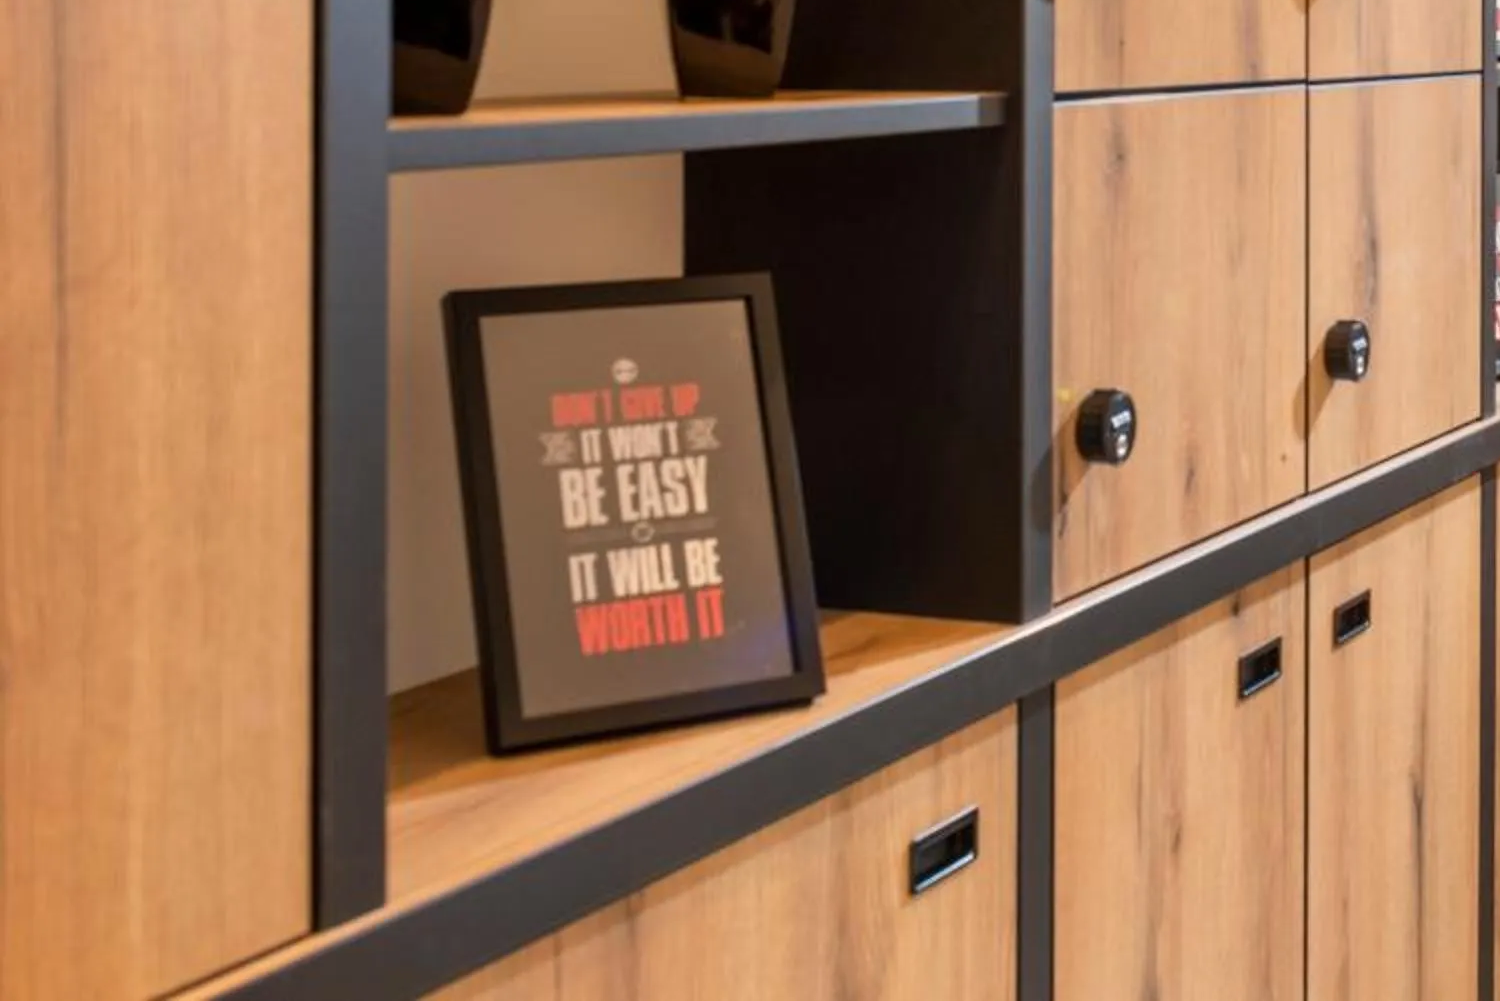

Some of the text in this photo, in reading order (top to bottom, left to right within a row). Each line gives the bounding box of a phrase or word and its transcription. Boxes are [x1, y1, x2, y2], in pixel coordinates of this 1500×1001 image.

[669, 382, 699, 416] UP
[580, 420, 679, 464] IT WON'T
[560, 455, 708, 528] BE EASY
[569, 537, 724, 603] IT WILL BE
[575, 587, 724, 656] WORTH IT
